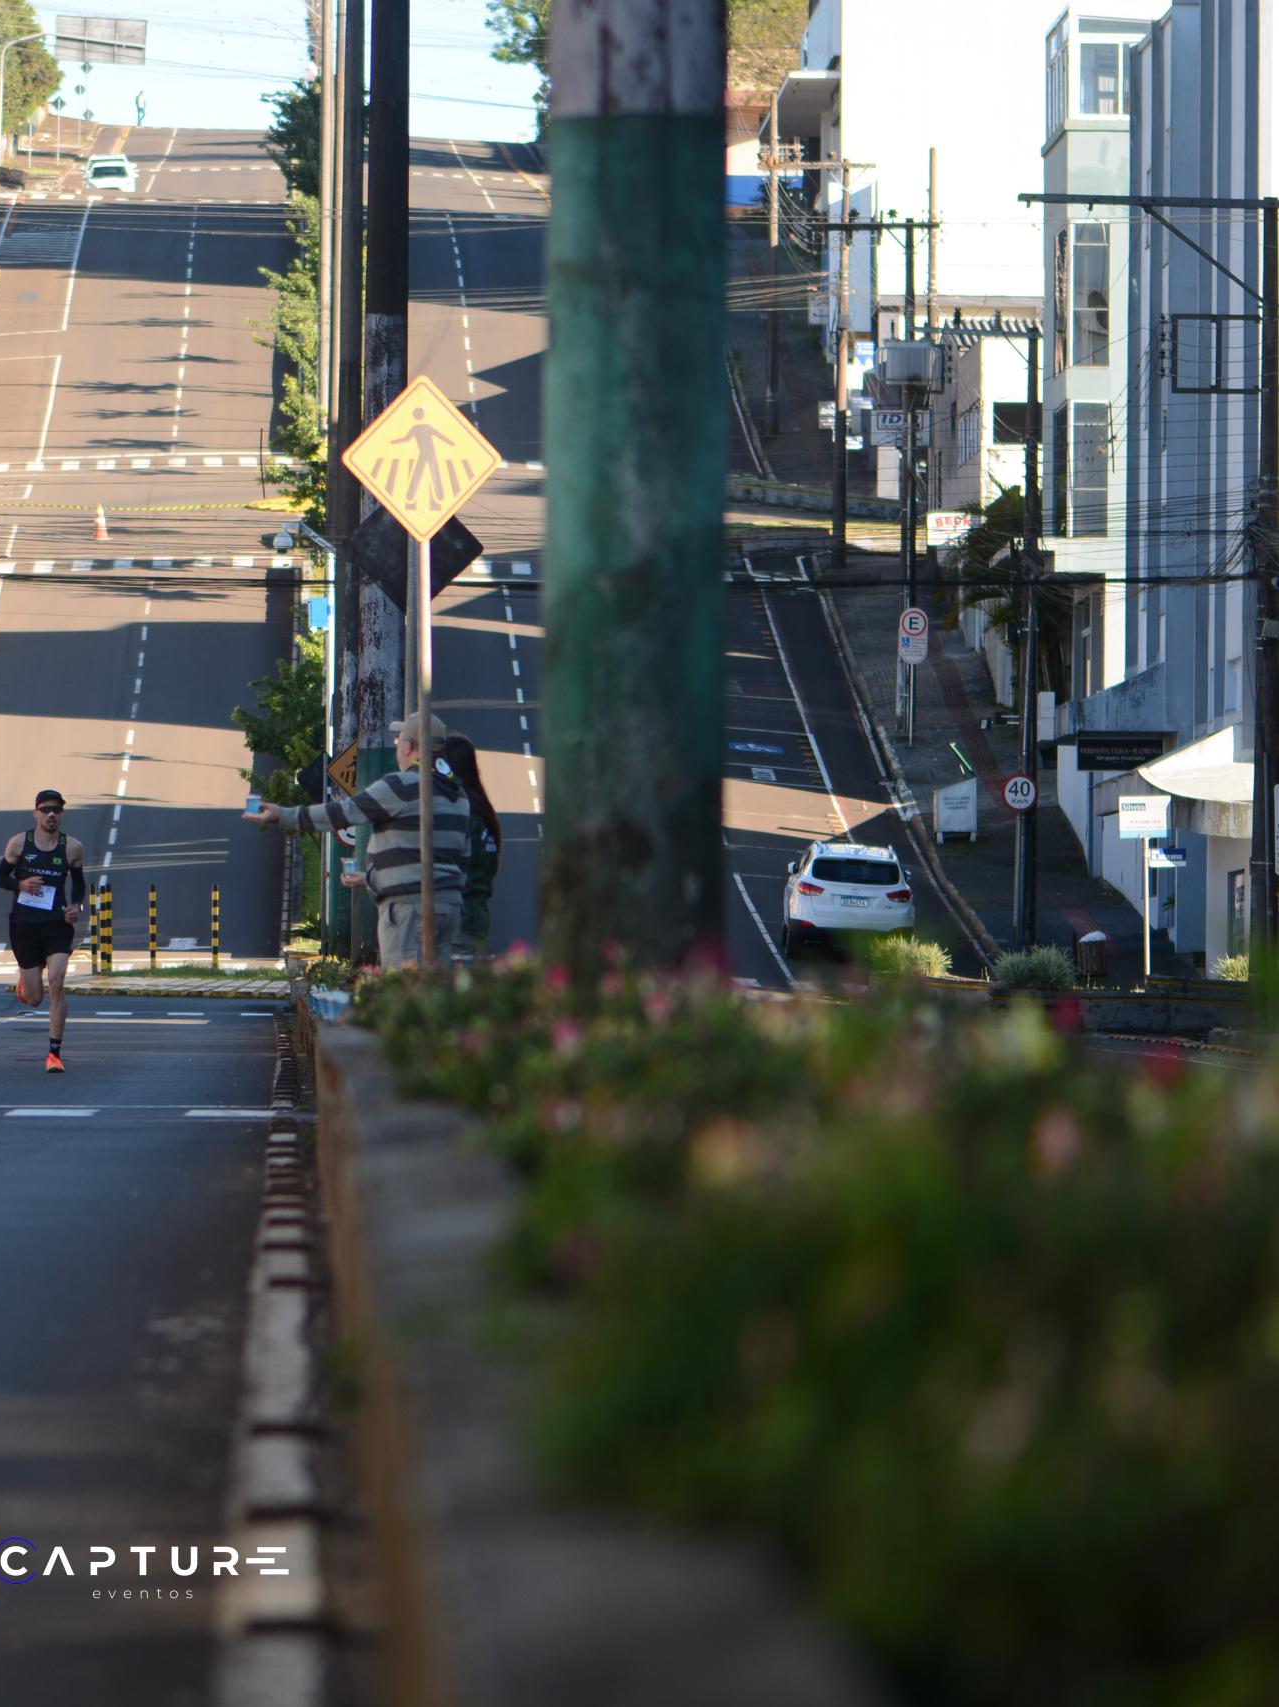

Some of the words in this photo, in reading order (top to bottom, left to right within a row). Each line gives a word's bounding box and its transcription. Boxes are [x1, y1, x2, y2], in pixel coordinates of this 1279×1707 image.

[909, 616, 920, 630] E
[1008, 781, 1031, 797] 40
[1122, 803, 1145, 811] Silveira
